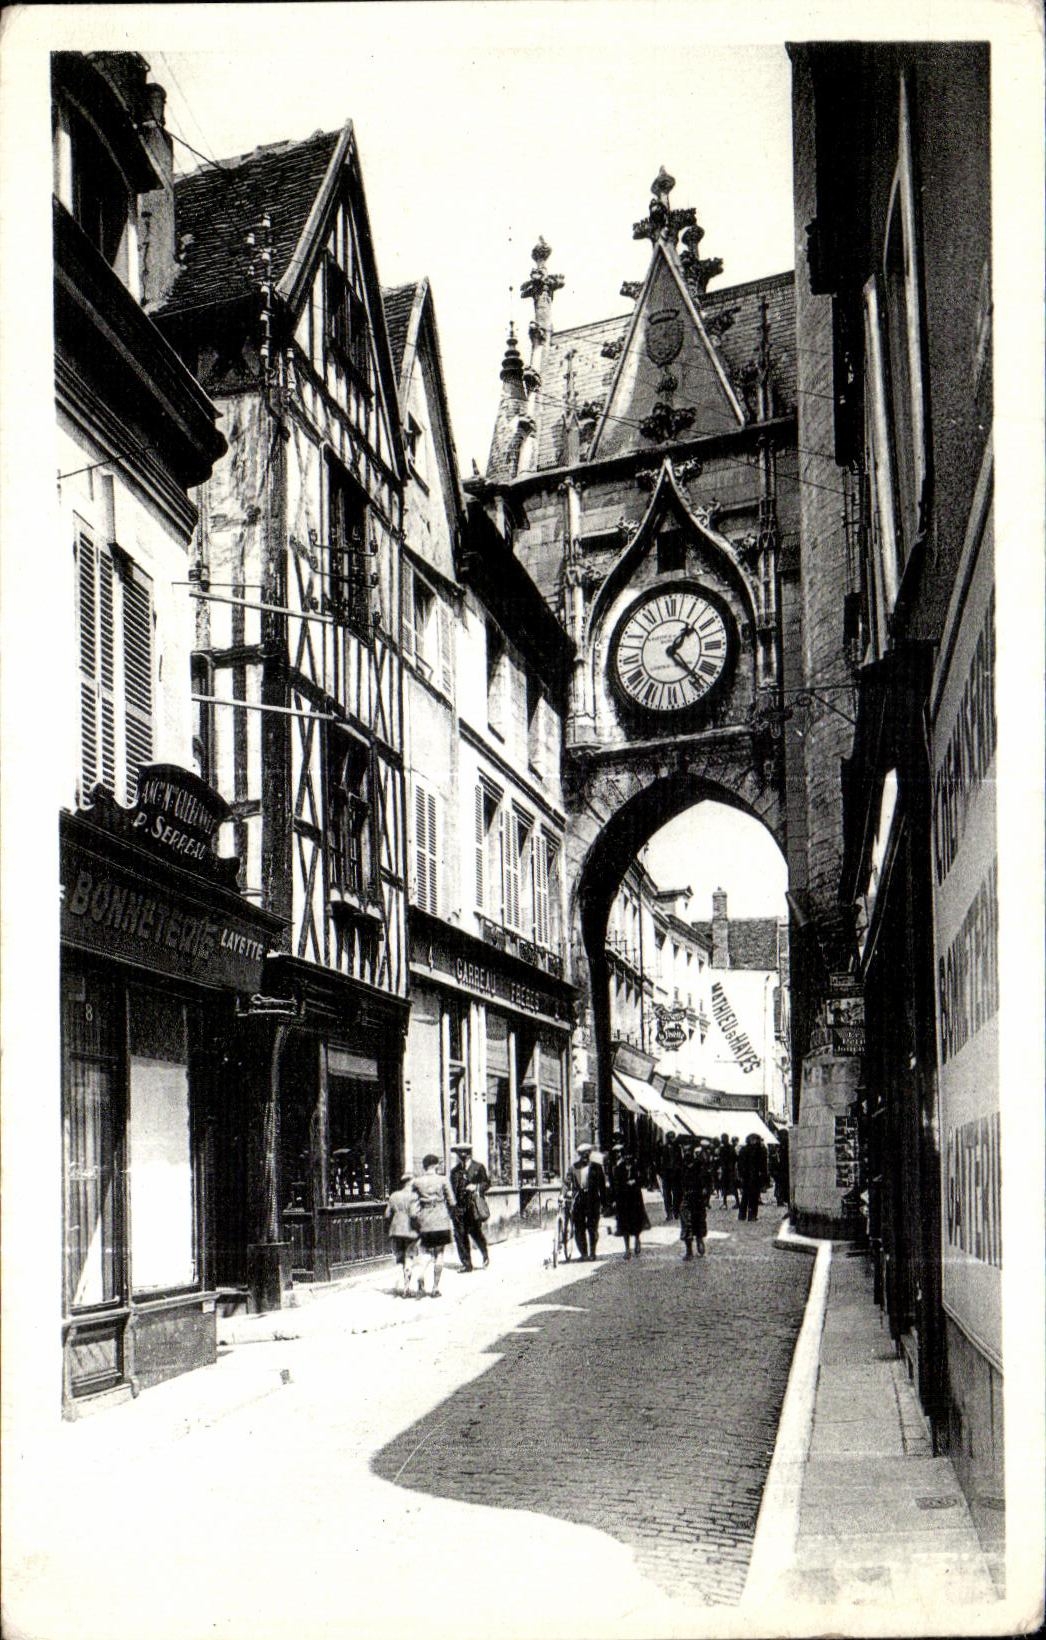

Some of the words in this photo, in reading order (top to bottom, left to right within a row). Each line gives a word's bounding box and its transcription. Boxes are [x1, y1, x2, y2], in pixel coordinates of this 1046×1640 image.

[220, 928, 263, 961] LAYETTE
[711, 982, 739, 1033] MATHIEU
[728, 1032, 761, 1074] HAYES
